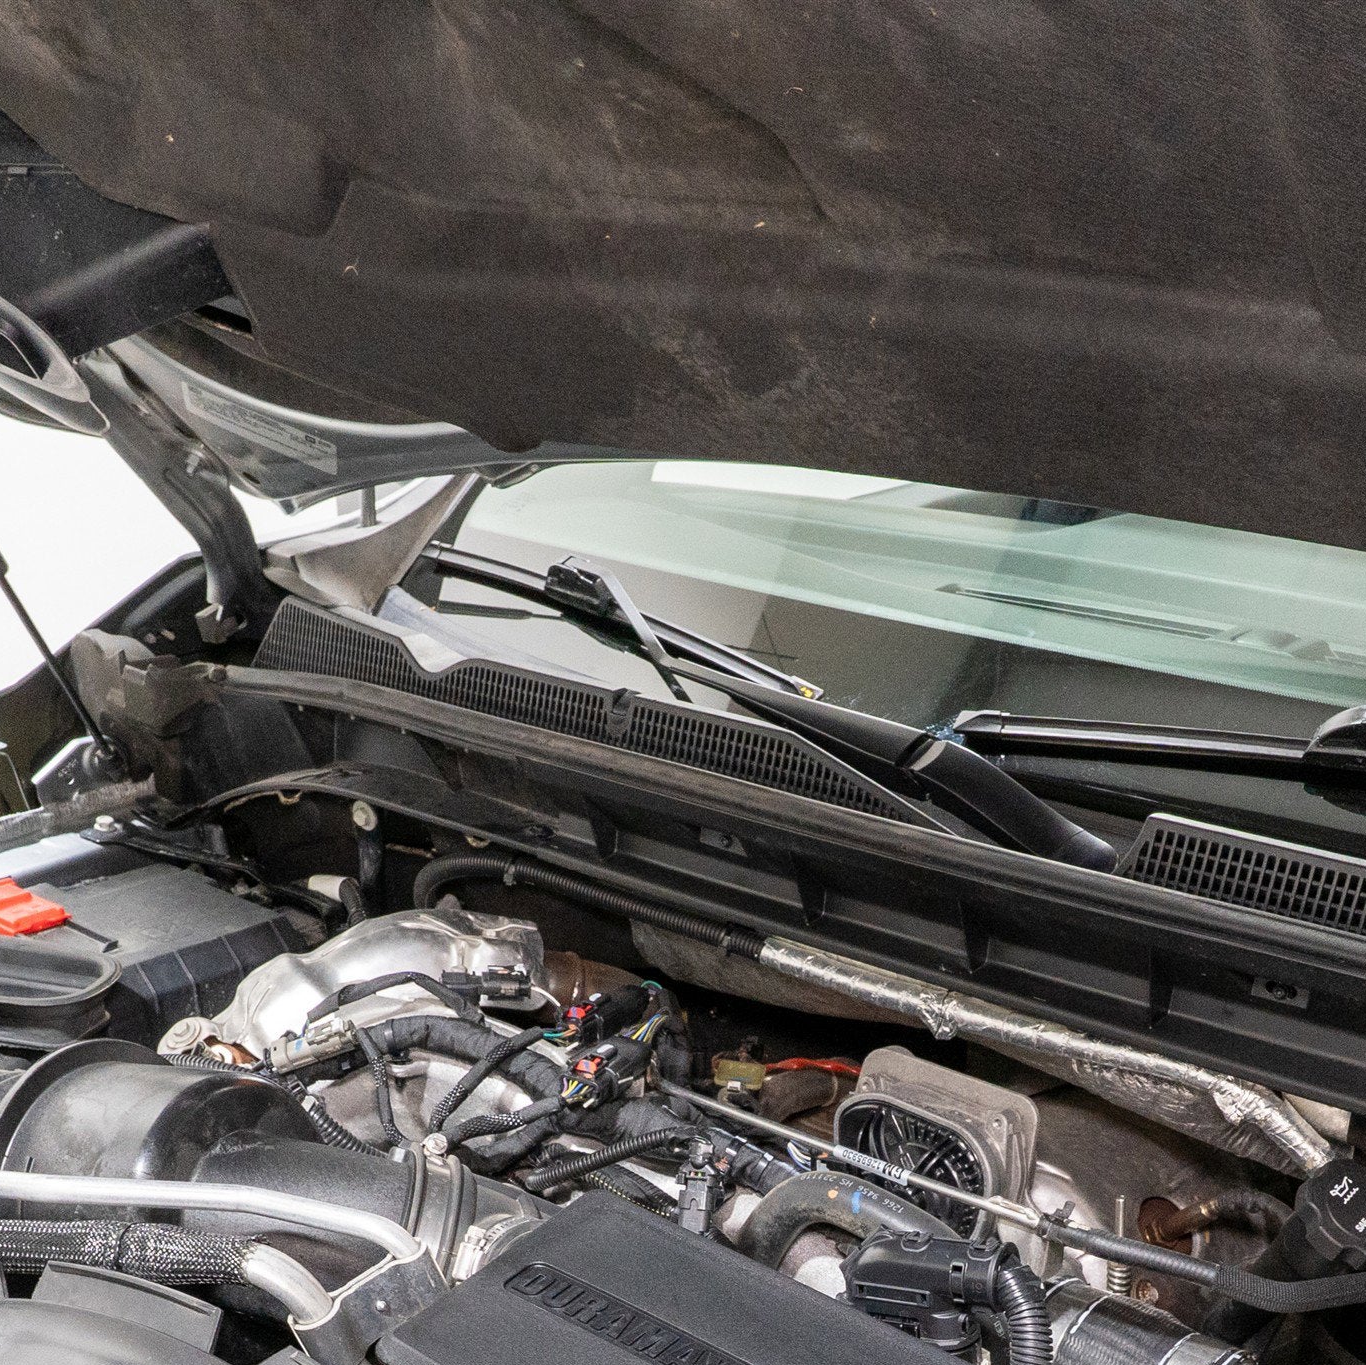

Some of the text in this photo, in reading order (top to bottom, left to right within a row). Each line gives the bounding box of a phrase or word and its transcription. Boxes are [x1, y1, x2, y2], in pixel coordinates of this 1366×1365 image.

[882, 1162, 904, 1179] GM
[838, 1177, 853, 1187] HS
[856, 1185, 878, 1200] 9456
[882, 1198, 904, 1214] 1266
